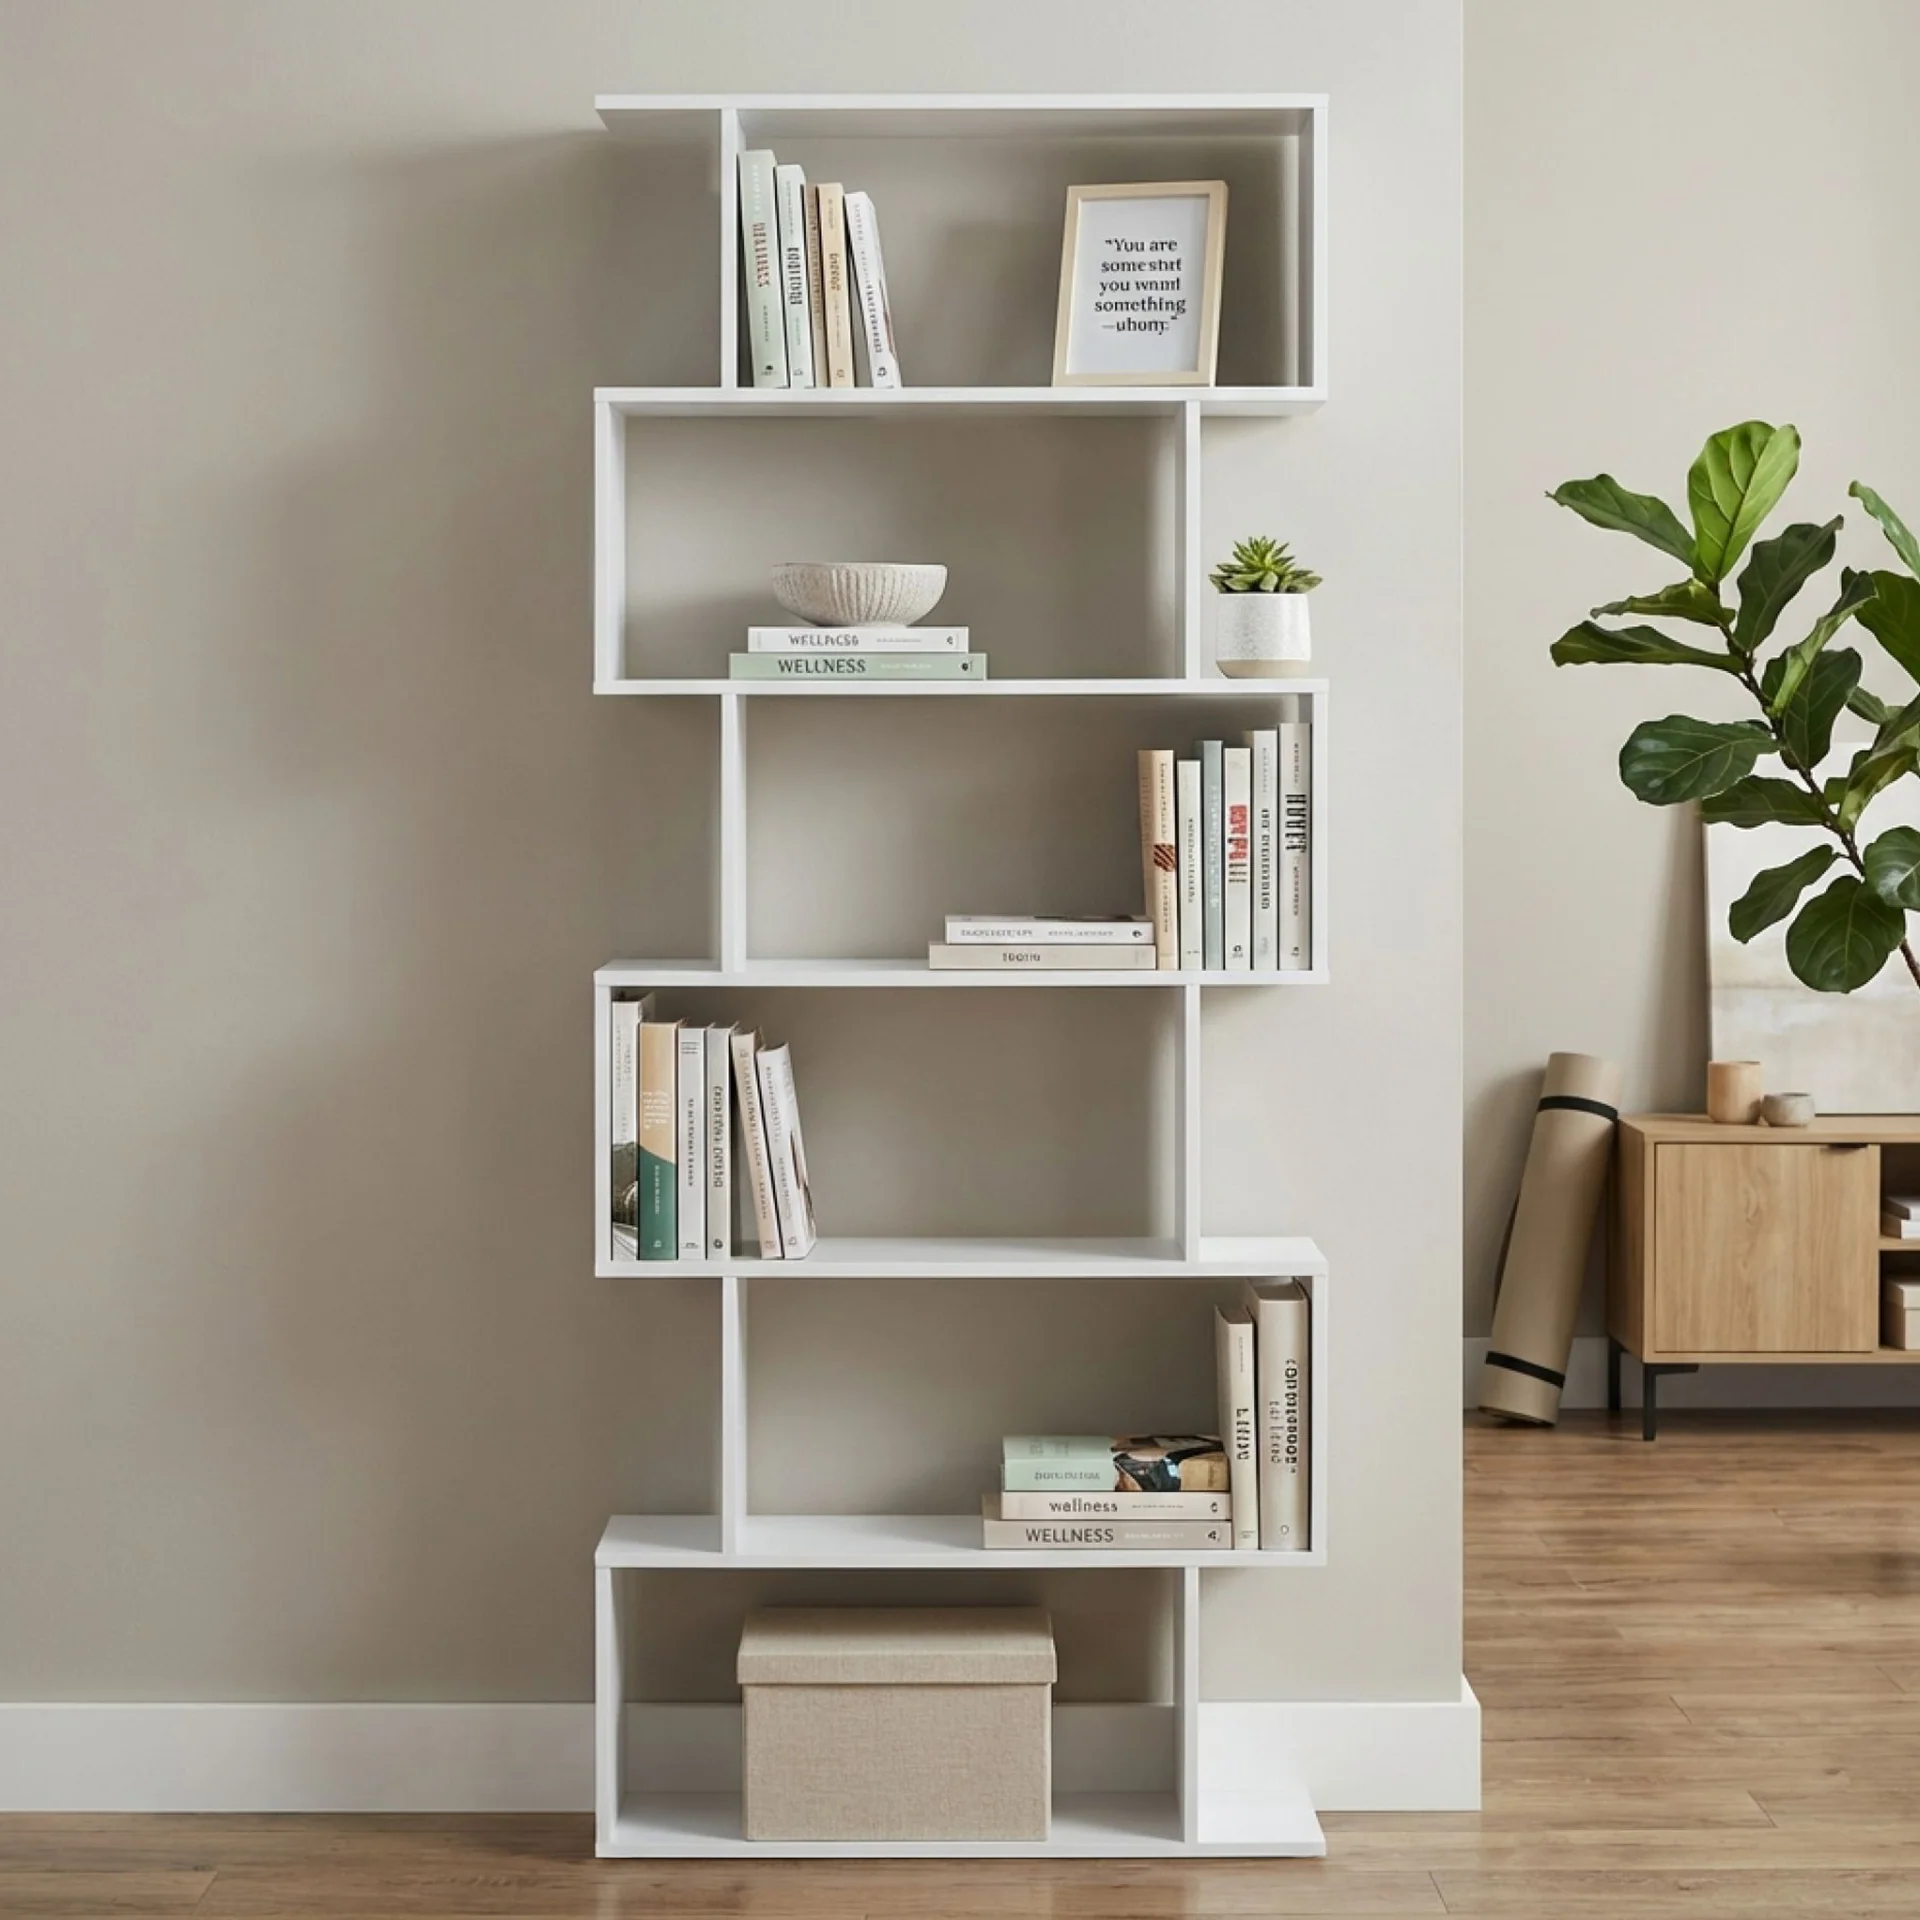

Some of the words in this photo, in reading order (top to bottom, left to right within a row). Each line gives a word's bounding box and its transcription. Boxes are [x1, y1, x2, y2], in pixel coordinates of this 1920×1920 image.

[1149, 240, 1178, 252] are
[1099, 280, 1130, 297] you
[1094, 296, 1186, 320] something
[778, 658, 866, 674] WELLNESS
[1025, 1528, 1115, 1543] WELLNESS
